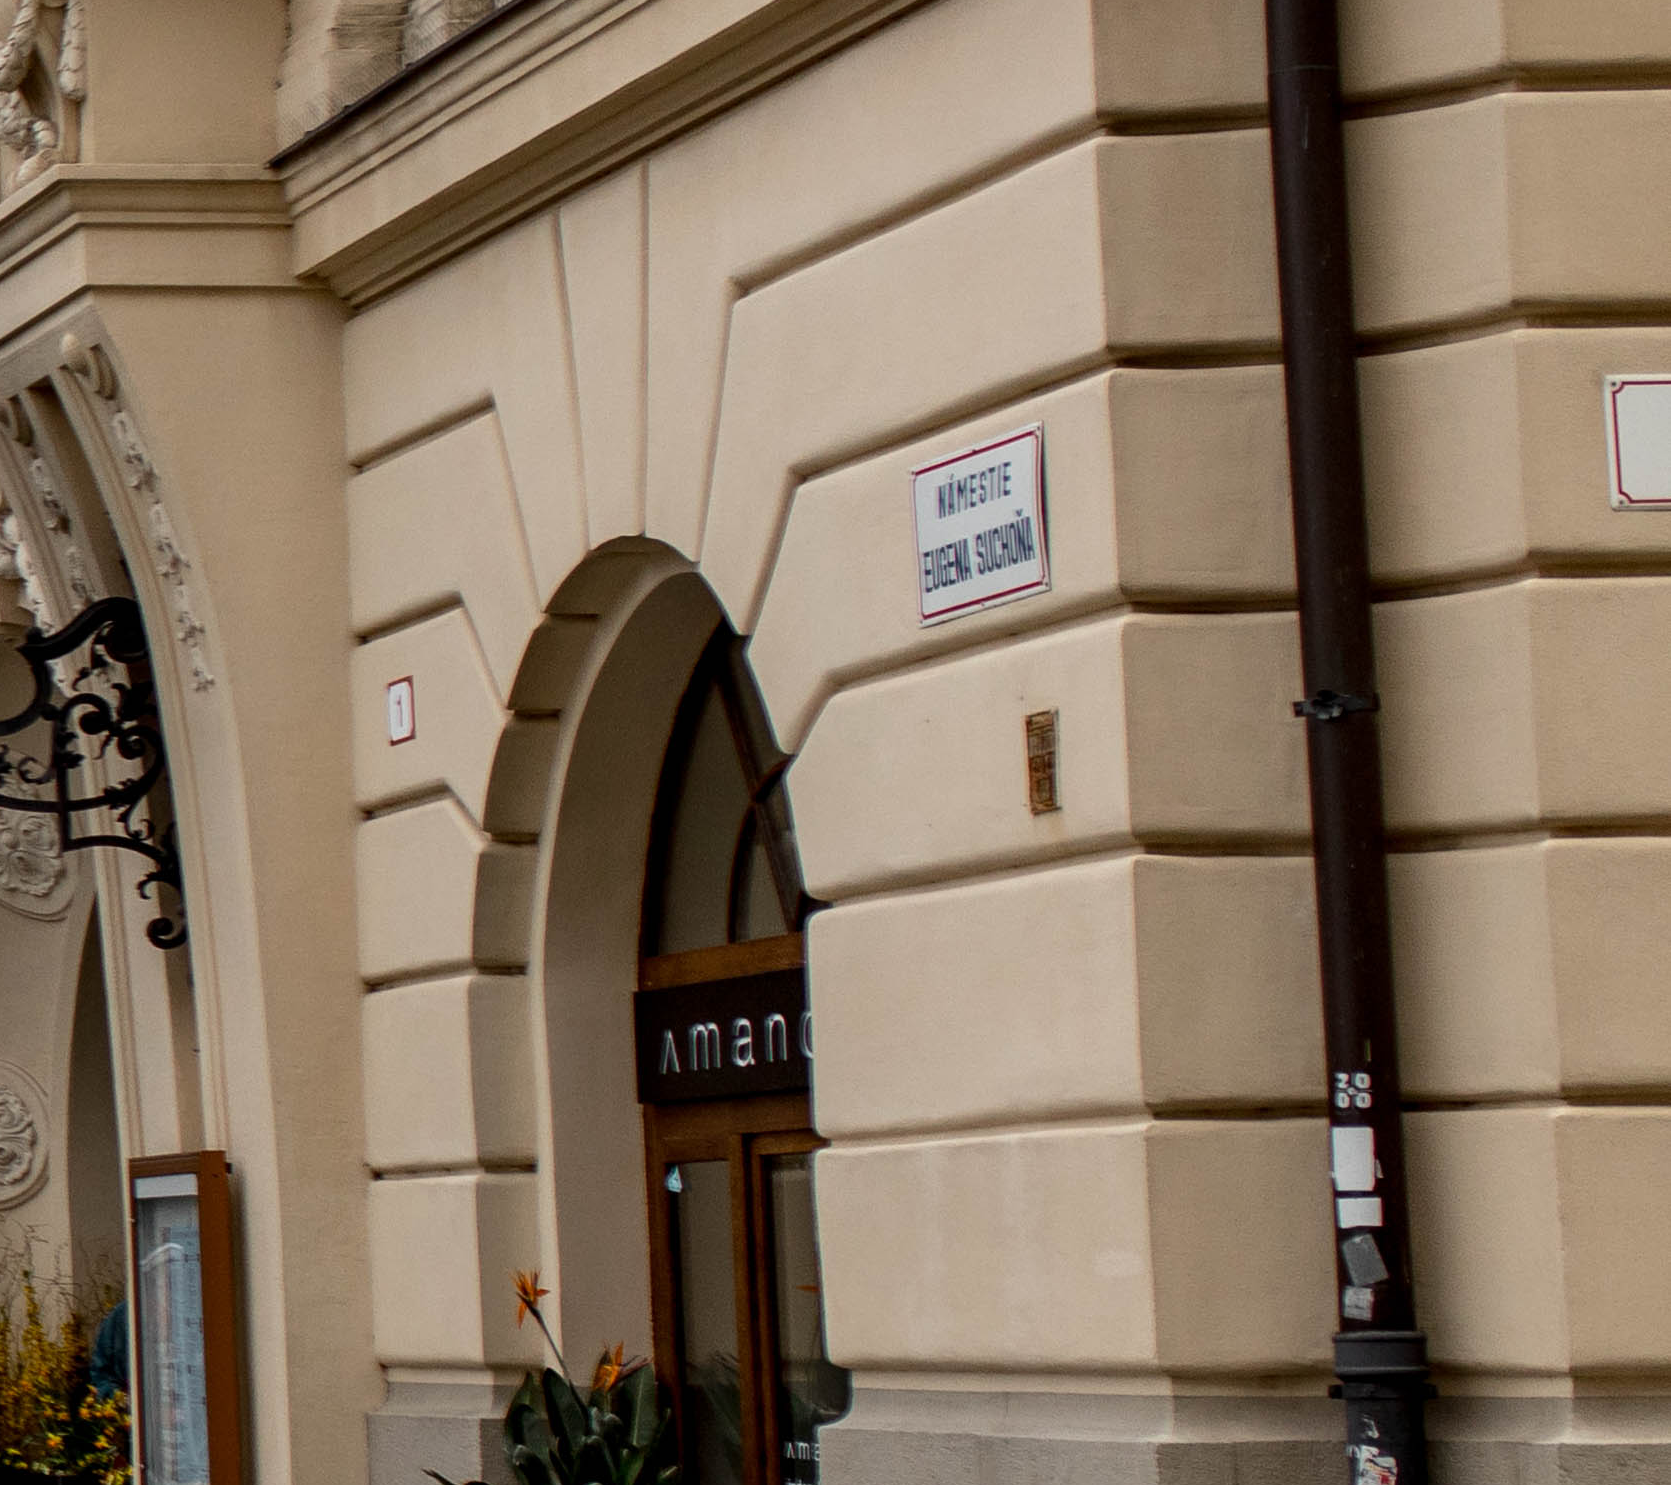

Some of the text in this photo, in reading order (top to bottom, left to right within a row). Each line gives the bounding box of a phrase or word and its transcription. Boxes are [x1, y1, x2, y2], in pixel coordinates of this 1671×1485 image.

[938, 462, 1012, 519] NÁMESTIE
[923, 508, 1035, 593] EUGENA SUCHOŇA
